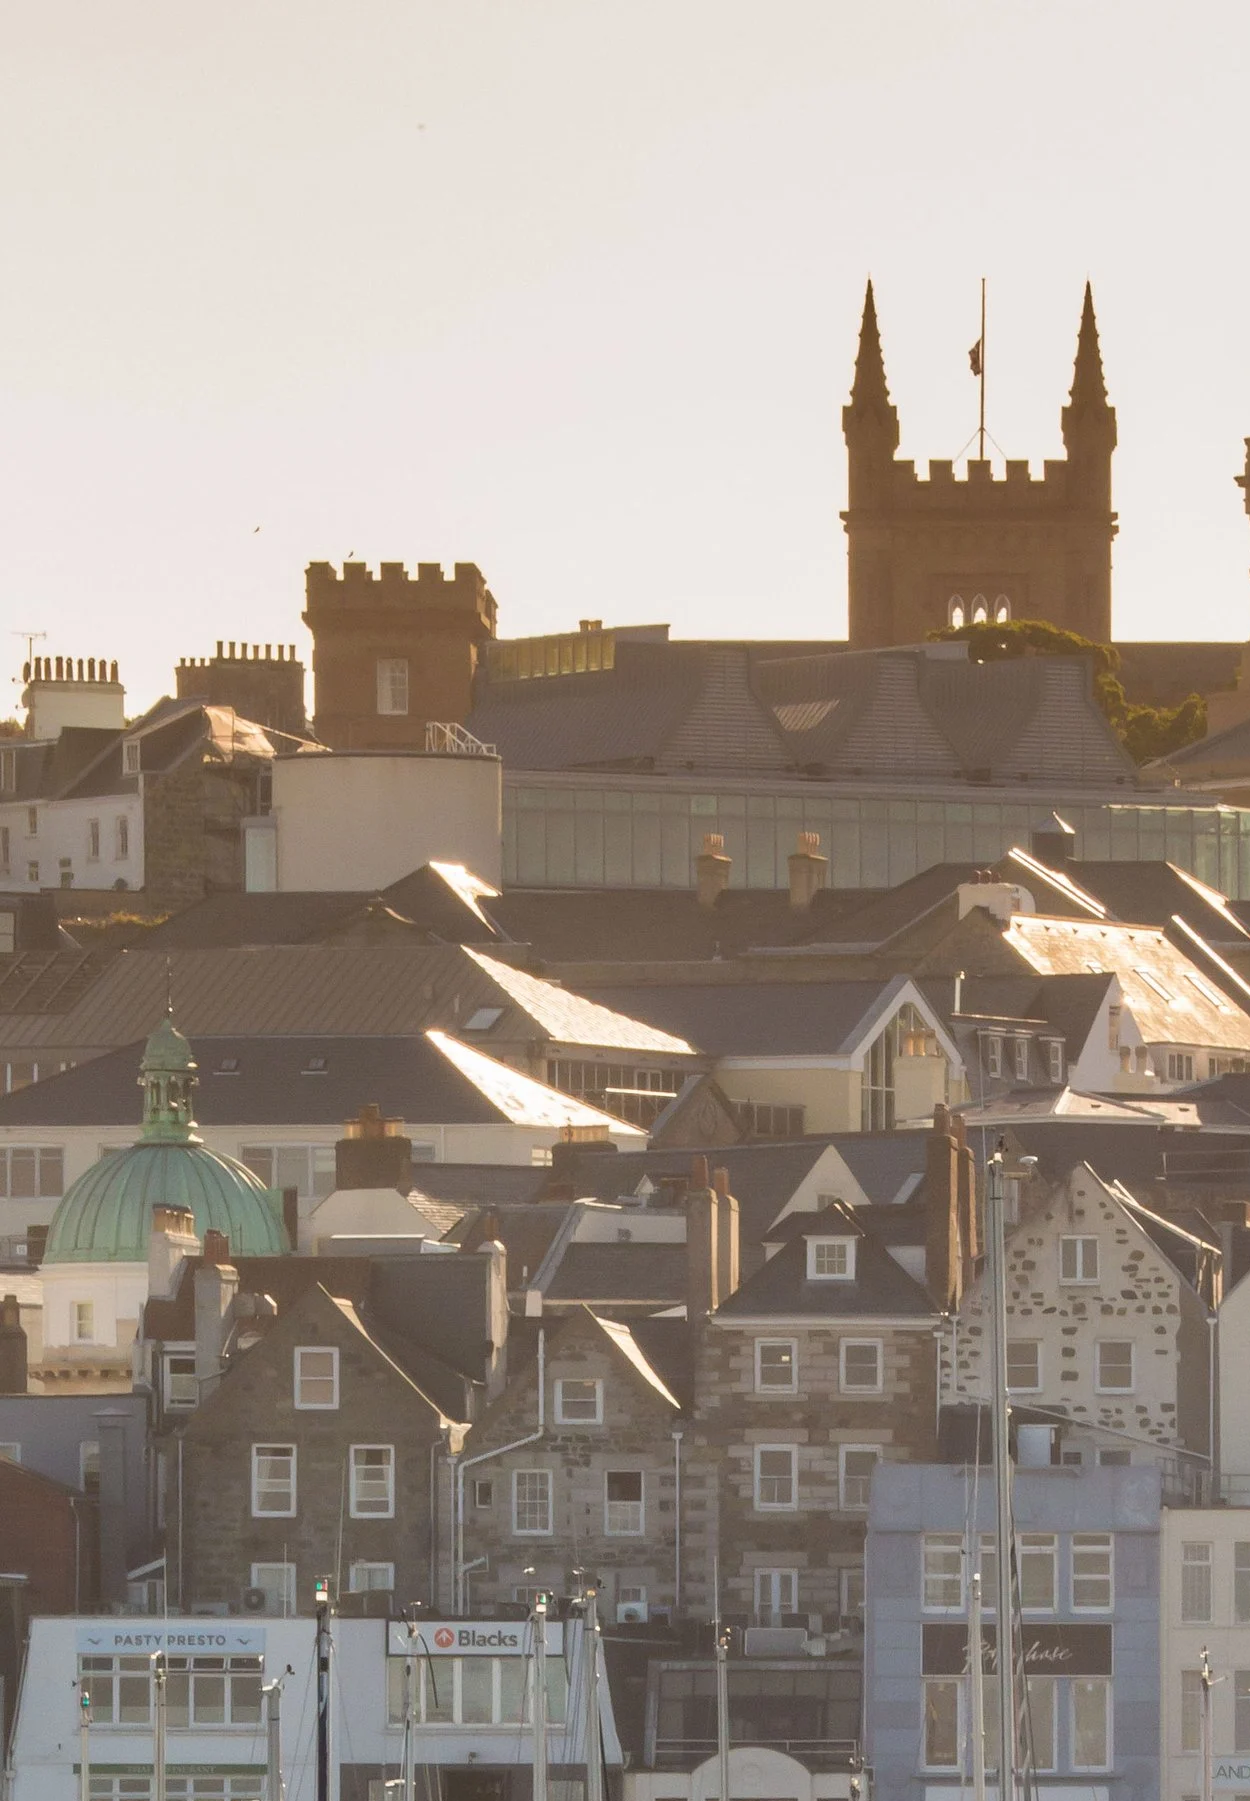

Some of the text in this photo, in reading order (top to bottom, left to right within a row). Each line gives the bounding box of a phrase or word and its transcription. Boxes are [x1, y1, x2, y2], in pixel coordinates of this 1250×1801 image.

[114, 1634, 226, 1646] PASTY PRESTO
[458, 1629, 518, 1647] Blacks
